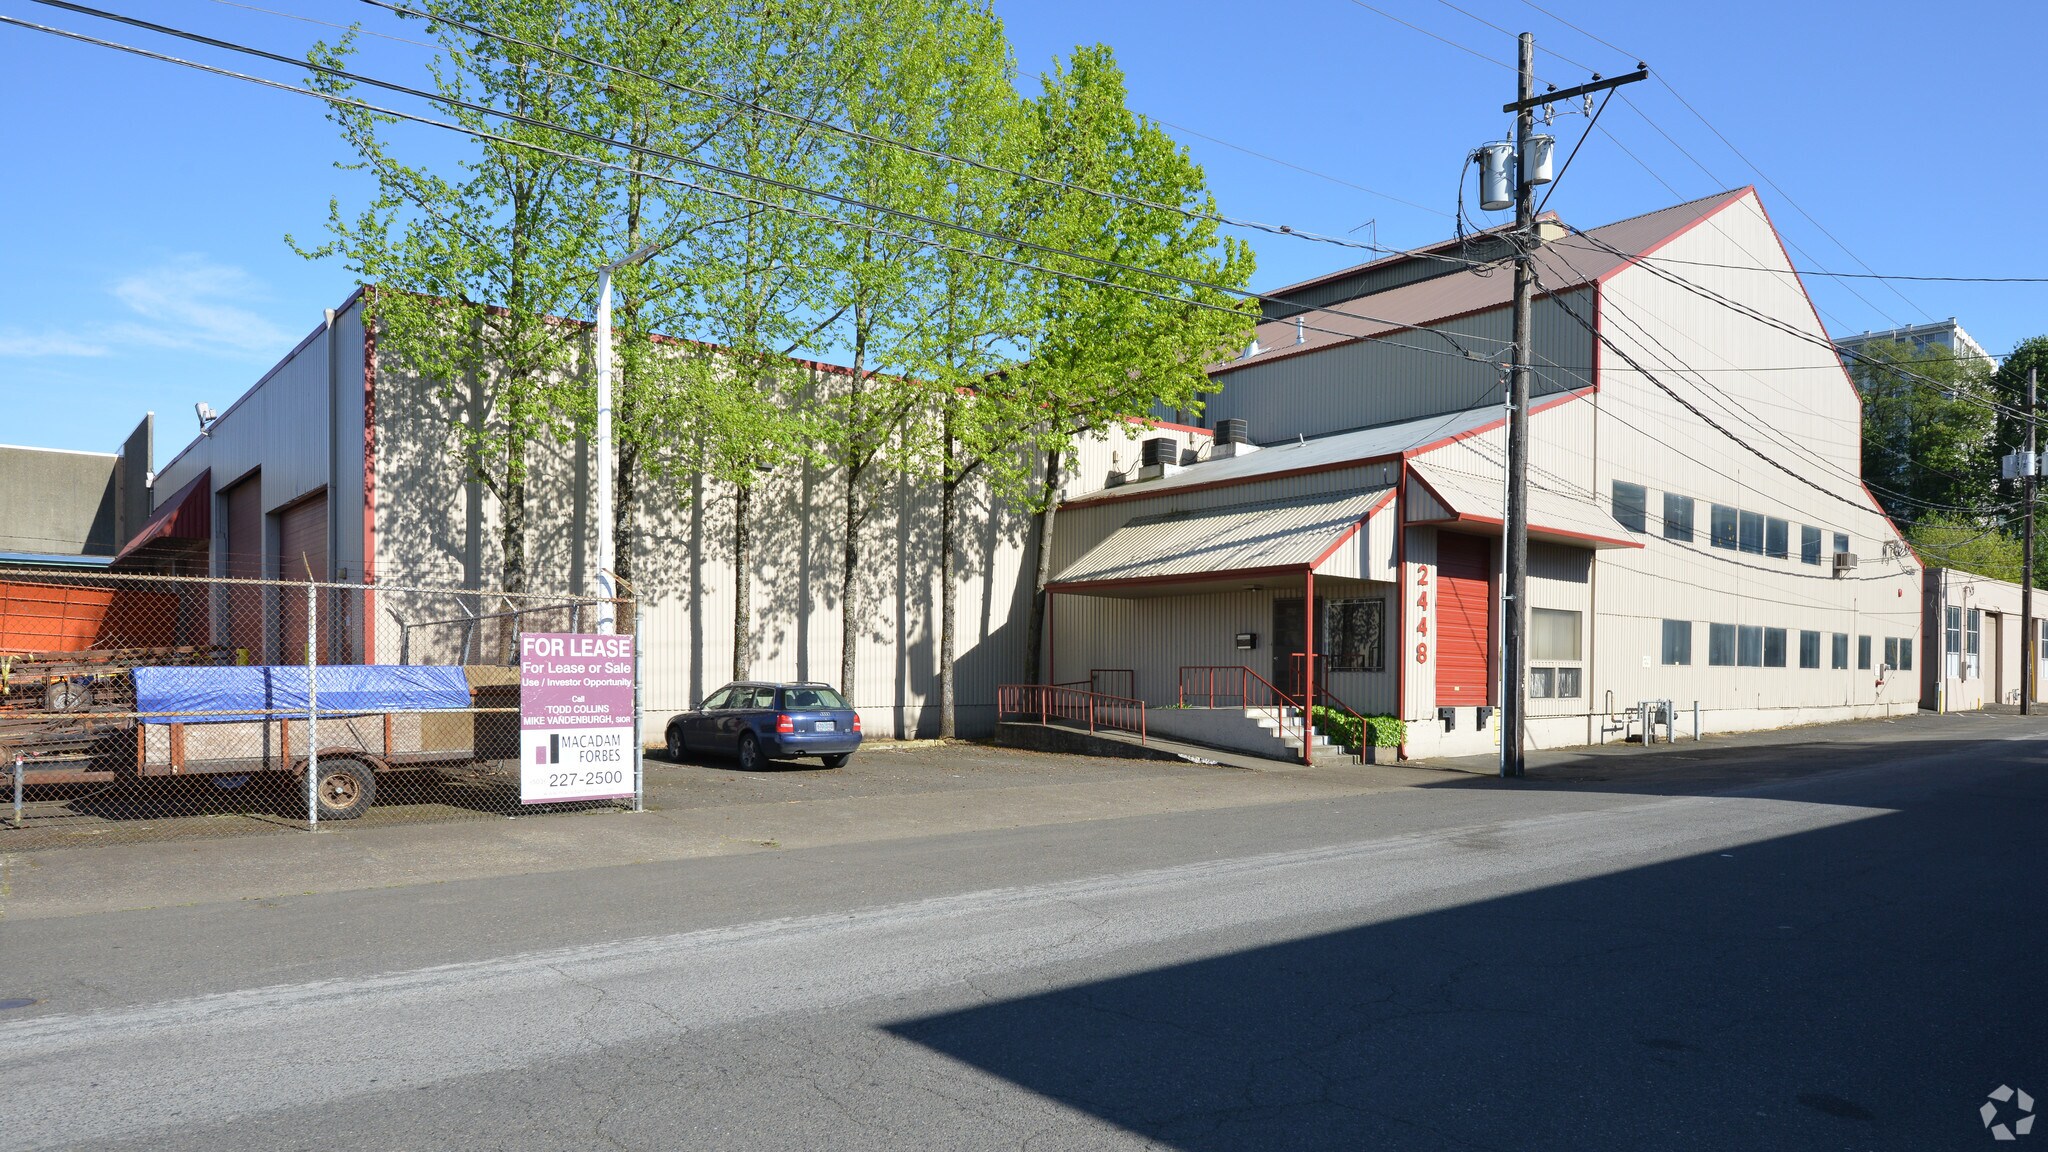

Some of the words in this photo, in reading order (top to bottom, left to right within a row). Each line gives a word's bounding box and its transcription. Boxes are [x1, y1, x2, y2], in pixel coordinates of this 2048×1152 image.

[1416, 565, 1428, 664] 2448
[523, 638, 564, 656] FOR
[570, 638, 630, 657] LEASE
[523, 662, 544, 673] For
[548, 662, 585, 673] Lease
[589, 665, 601, 673] or
[605, 662, 631, 673] Sale
[523, 678, 539, 686] Use
[547, 678, 581, 686] Investor
[584, 678, 631, 688] Opportunity
[548, 705, 572, 714] TODD
[574, 705, 609, 713] COLLINS
[524, 717, 545, 725] MIKE
[547, 716, 613, 724] VANDENBURGH,
[562, 735, 620, 748] MACADAM
[580, 750, 620, 762] FORBES
[550, 771, 622, 787] 227-2500
